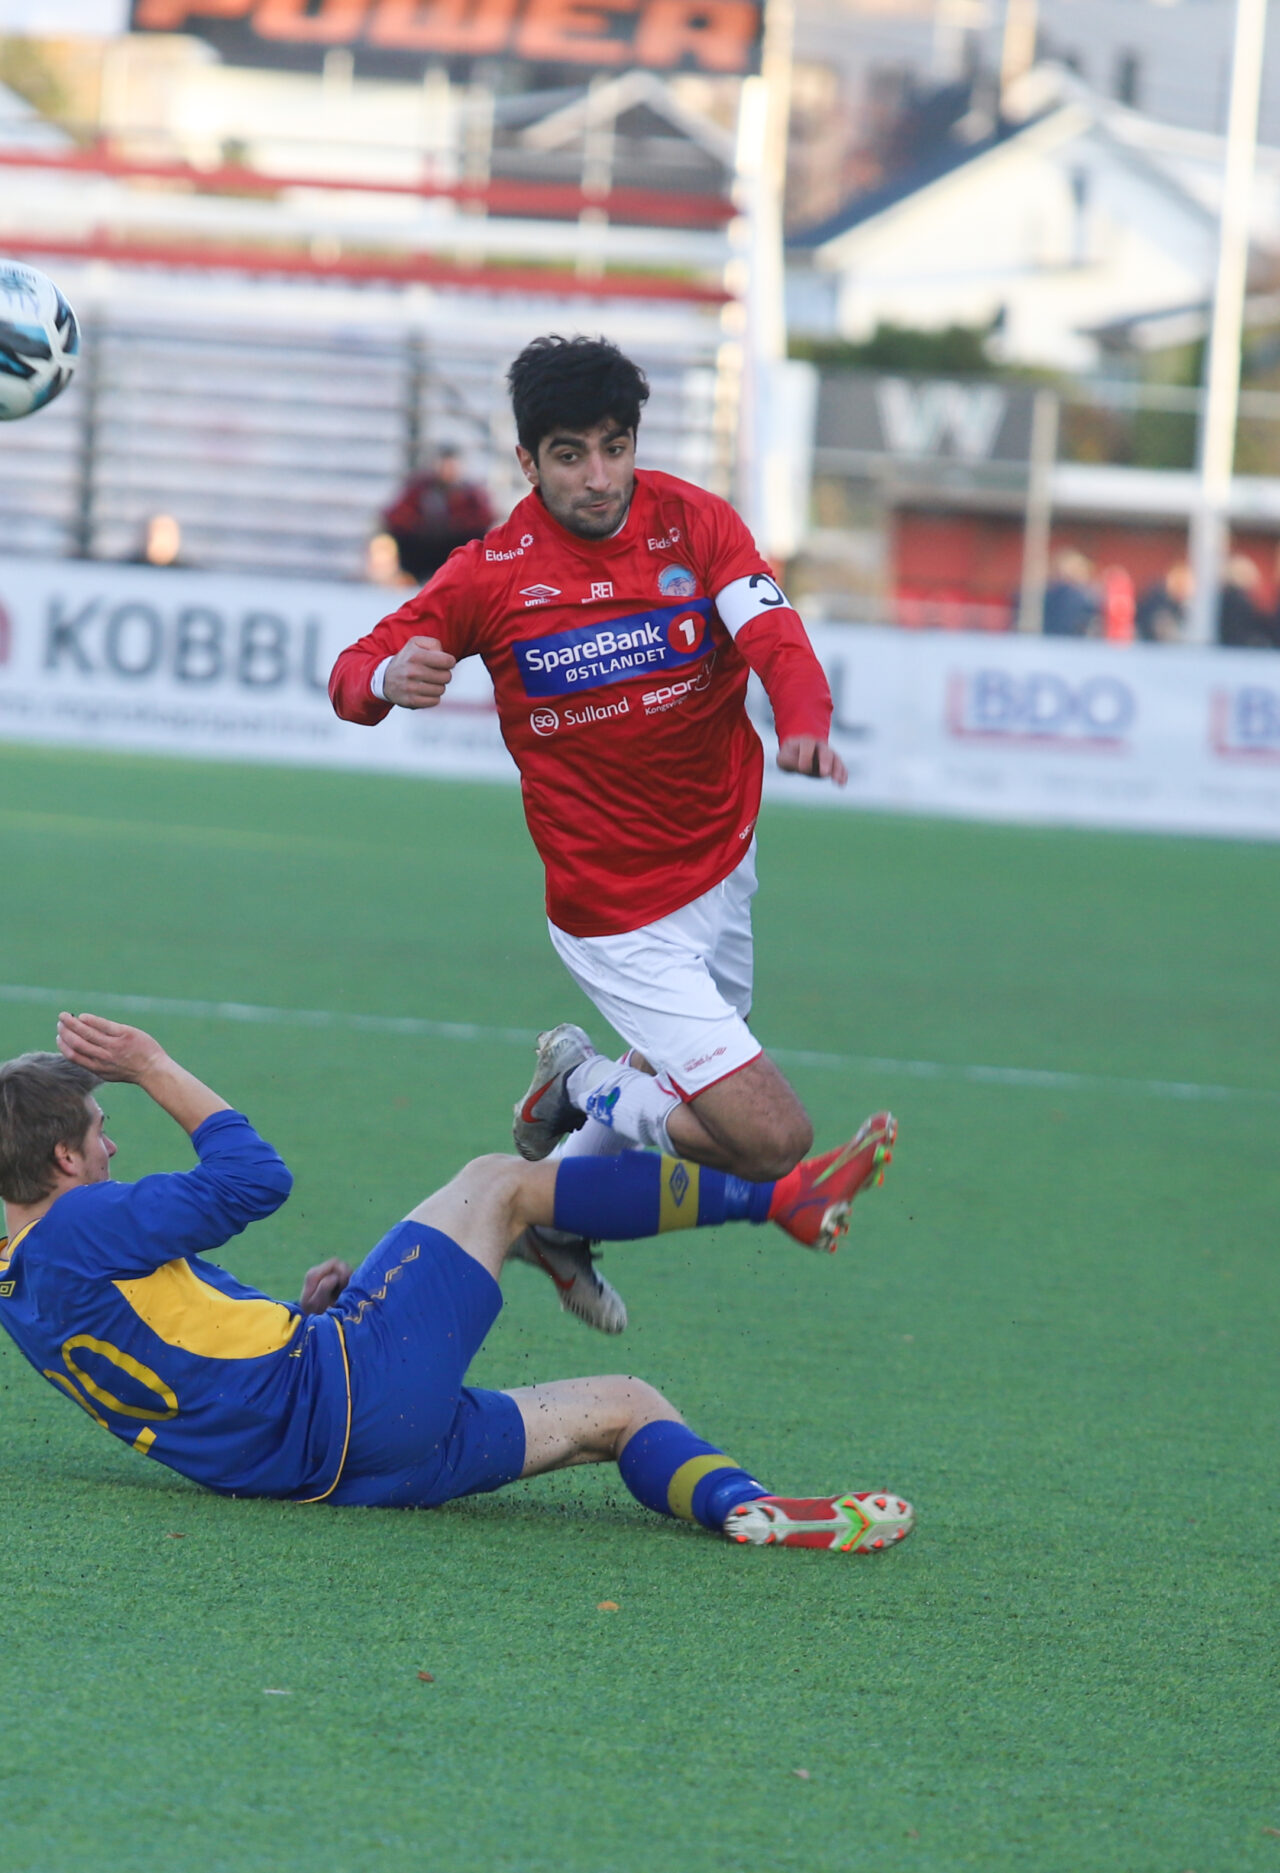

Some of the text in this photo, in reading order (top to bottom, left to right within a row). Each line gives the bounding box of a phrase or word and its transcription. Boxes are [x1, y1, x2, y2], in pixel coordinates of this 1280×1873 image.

[485, 547, 524, 561] Eidsiva
[524, 595, 552, 607] umb
[525, 618, 696, 673] SpareBank 1
[565, 647, 667, 683] ØSTLANDET
[564, 696, 630, 726] Sulland
[972, 667, 1136, 734] BDO
